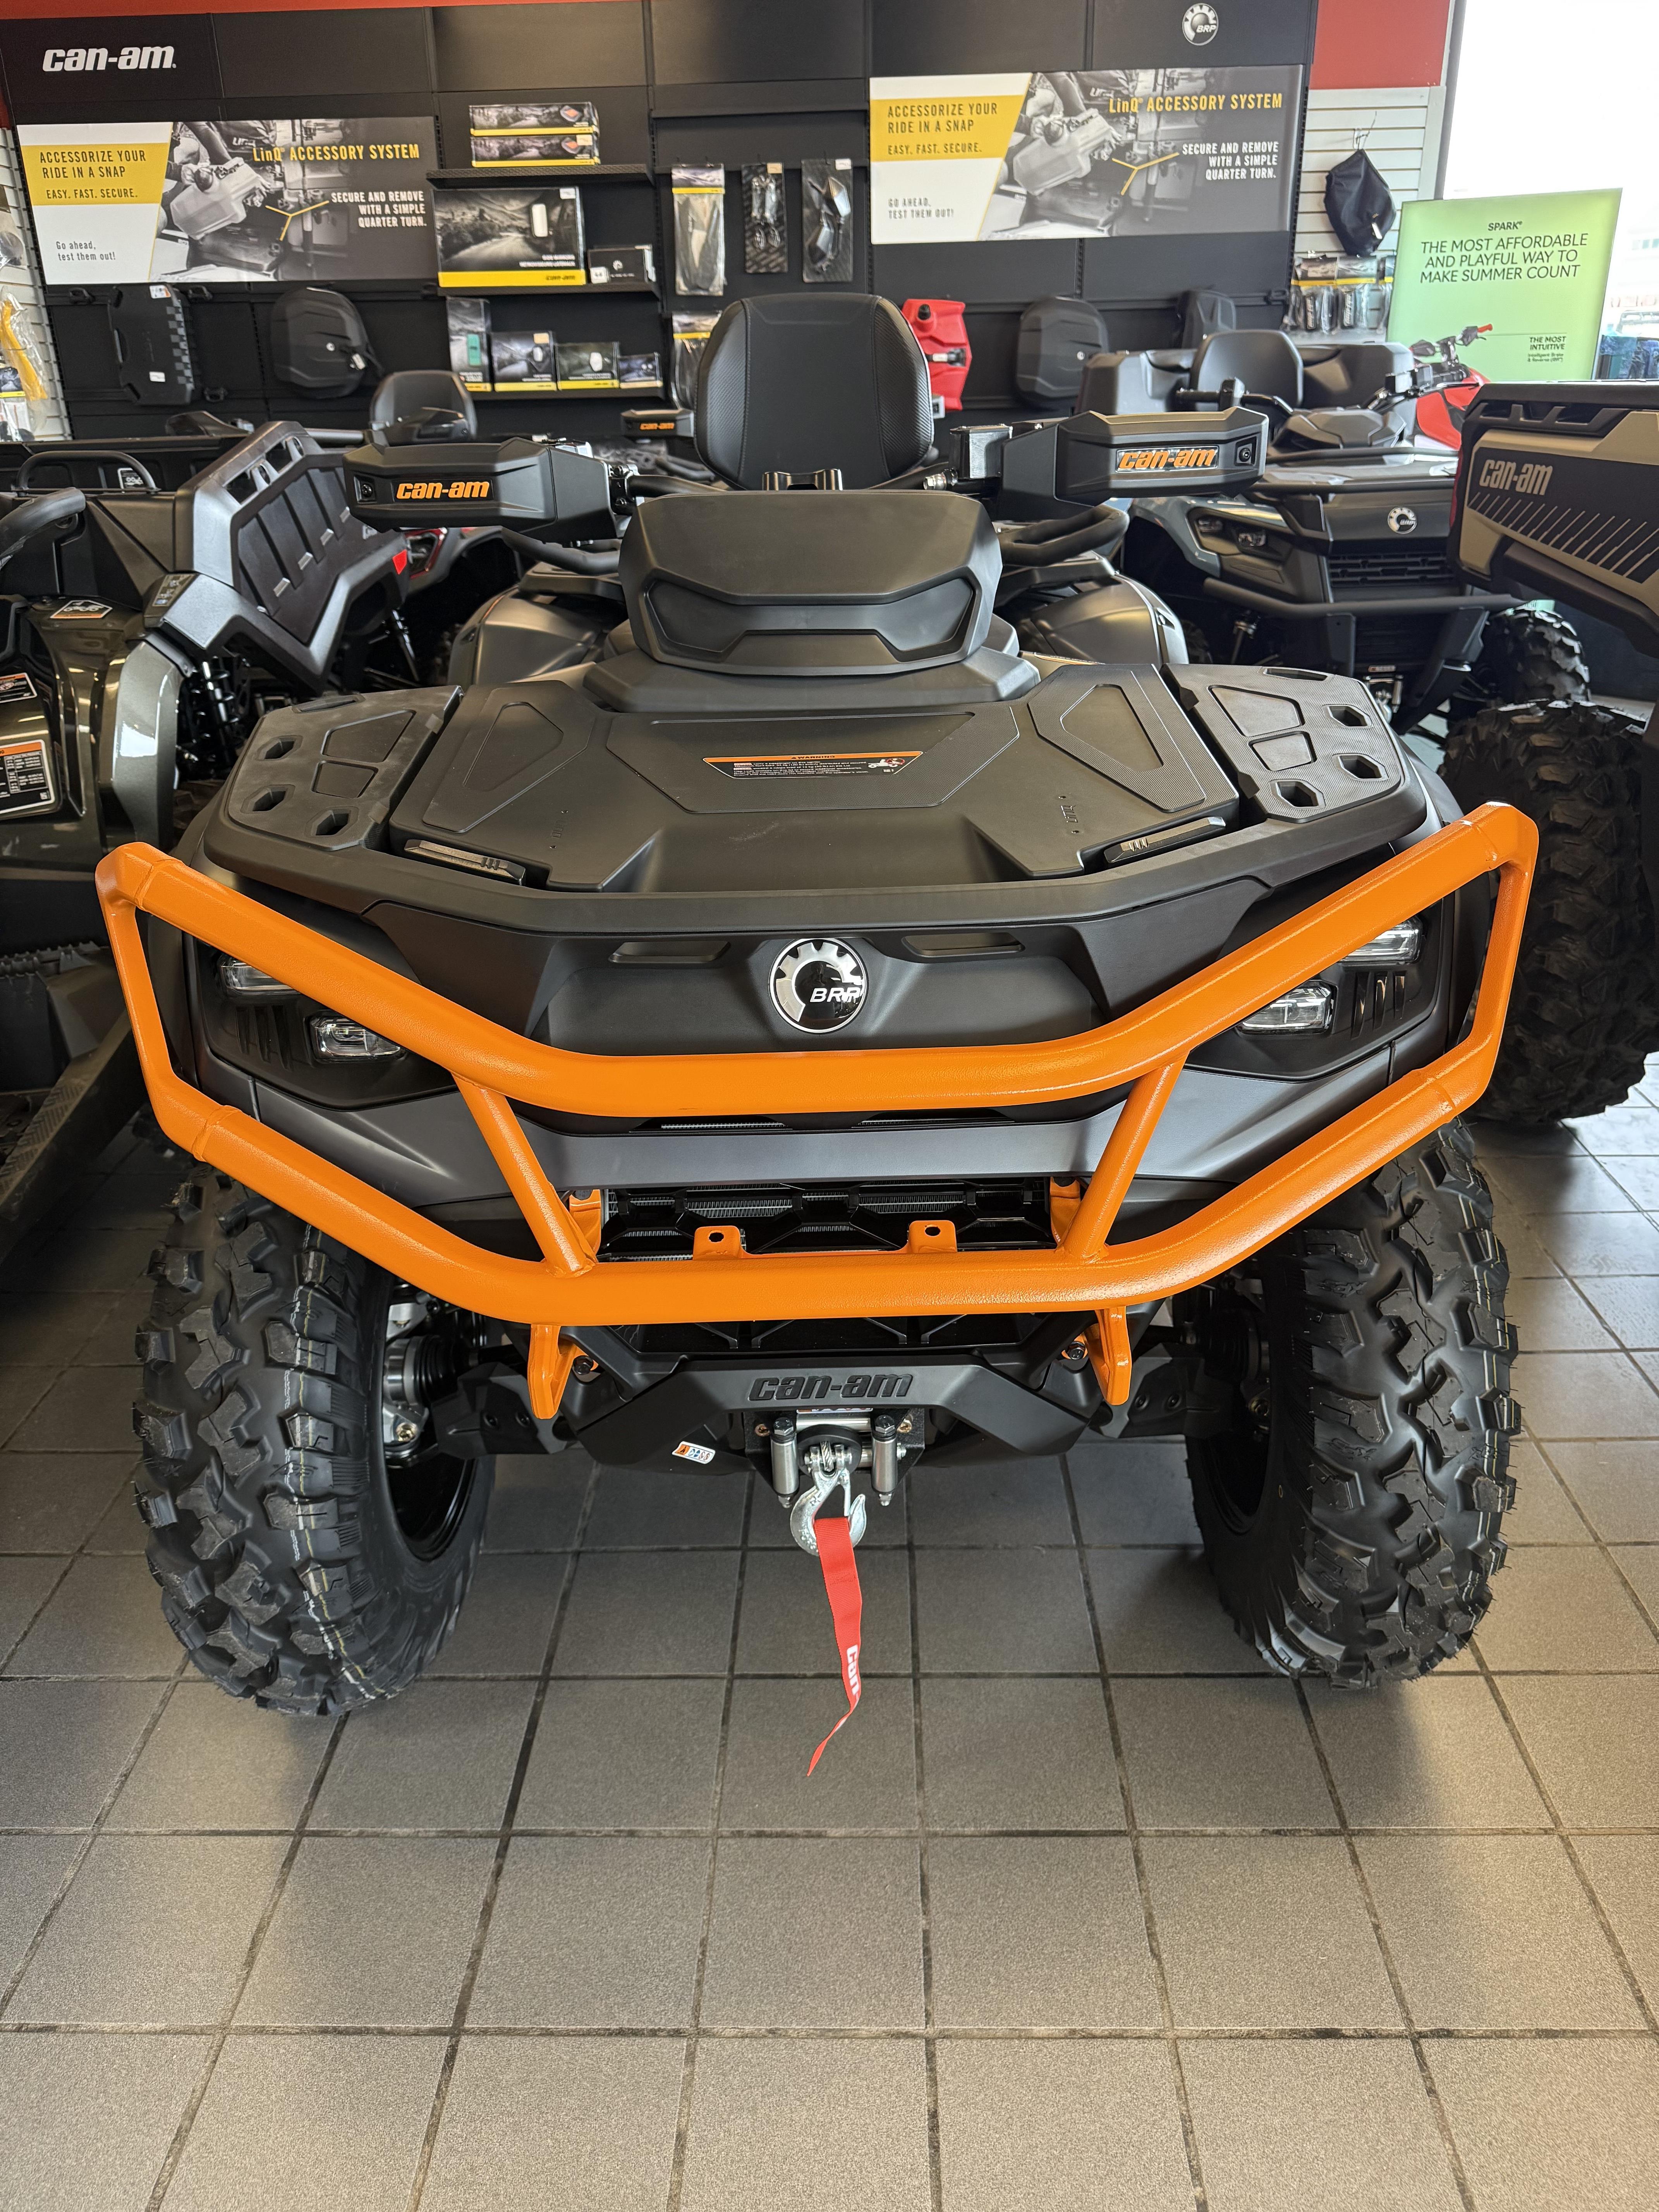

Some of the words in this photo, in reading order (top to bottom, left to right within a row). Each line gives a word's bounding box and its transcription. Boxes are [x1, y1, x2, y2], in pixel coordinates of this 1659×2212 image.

[1196, 25, 1216, 33] BRP
[1147, 95, 1225, 112] ACCESSORY
[1231, 93, 1282, 110] SYSTEM
[888, 104, 964, 118] ACCESSORIZE
[969, 102, 997, 115] YOUR
[888, 121, 914, 134] RIDE
[919, 121, 930, 132] IN
[935, 120, 941, 132] A
[946, 119, 974, 132] SNAP
[290, 146, 363, 161] ACCESSORY
[369, 144, 419, 159] SYSTEM
[888, 144, 913, 155] EASY.
[916, 143, 940, 154] FAST.
[943, 142, 982, 153] SECURE.
[1182, 143, 1218, 155] SECURE
[1220, 142, 1239, 154] AND
[1242, 141, 1279, 153] REMOVE
[40, 151, 113, 163] ACCESSORIZE
[117, 150, 146, 162] YOUR
[1209, 156, 1231, 167] WITH
[1234, 155, 1240, 166] A
[1244, 154, 1278, 166] SIMPLE
[42, 167, 69, 179] RIDE
[72, 167, 84, 178] IN
[89, 167, 95, 178] A
[98, 166, 125, 178] SNAP
[1206, 168, 1247, 180] QUARTER
[1250, 167, 1276, 179] TURN.
[46, 189, 71, 199] EASY.
[74, 189, 97, 199] FAST.
[100, 188, 138, 198] SECURE.
[331, 192, 366, 203] SECURE
[368, 191, 386, 202] AND
[388, 191, 424, 202] REMOVE
[359, 204, 381, 215] WITH
[385, 204, 390, 214] A
[393, 203, 426, 214] SIMPLE
[358, 216, 398, 228] QUARTER
[400, 216, 427, 227] TURN.
[56, 241, 66, 250] Go
[1421, 240, 1448, 254] THE
[1451, 238, 1493, 252] MOST
[1495, 234, 1588, 250] AFFORDABLE
[58, 252, 74, 261] test
[77, 252, 96, 261] them
[100, 251, 116, 261] out!
[1425, 255, 1455, 268] AND
[1460, 252, 1518, 267] PLAYFUL
[1523, 251, 1554, 264] WAY
[1558, 249, 1578, 262] TO
[1420, 270, 1458, 283] MAKE
[1462, 267, 1522, 282] SUMMER
[1527, 264, 1581, 279] COUNT
[1119, 450, 1215, 469] can-am
[1479, 459, 1553, 495] can-am
[396, 482, 489, 499] can-am
[749, 1374, 914, 1401] can-am
